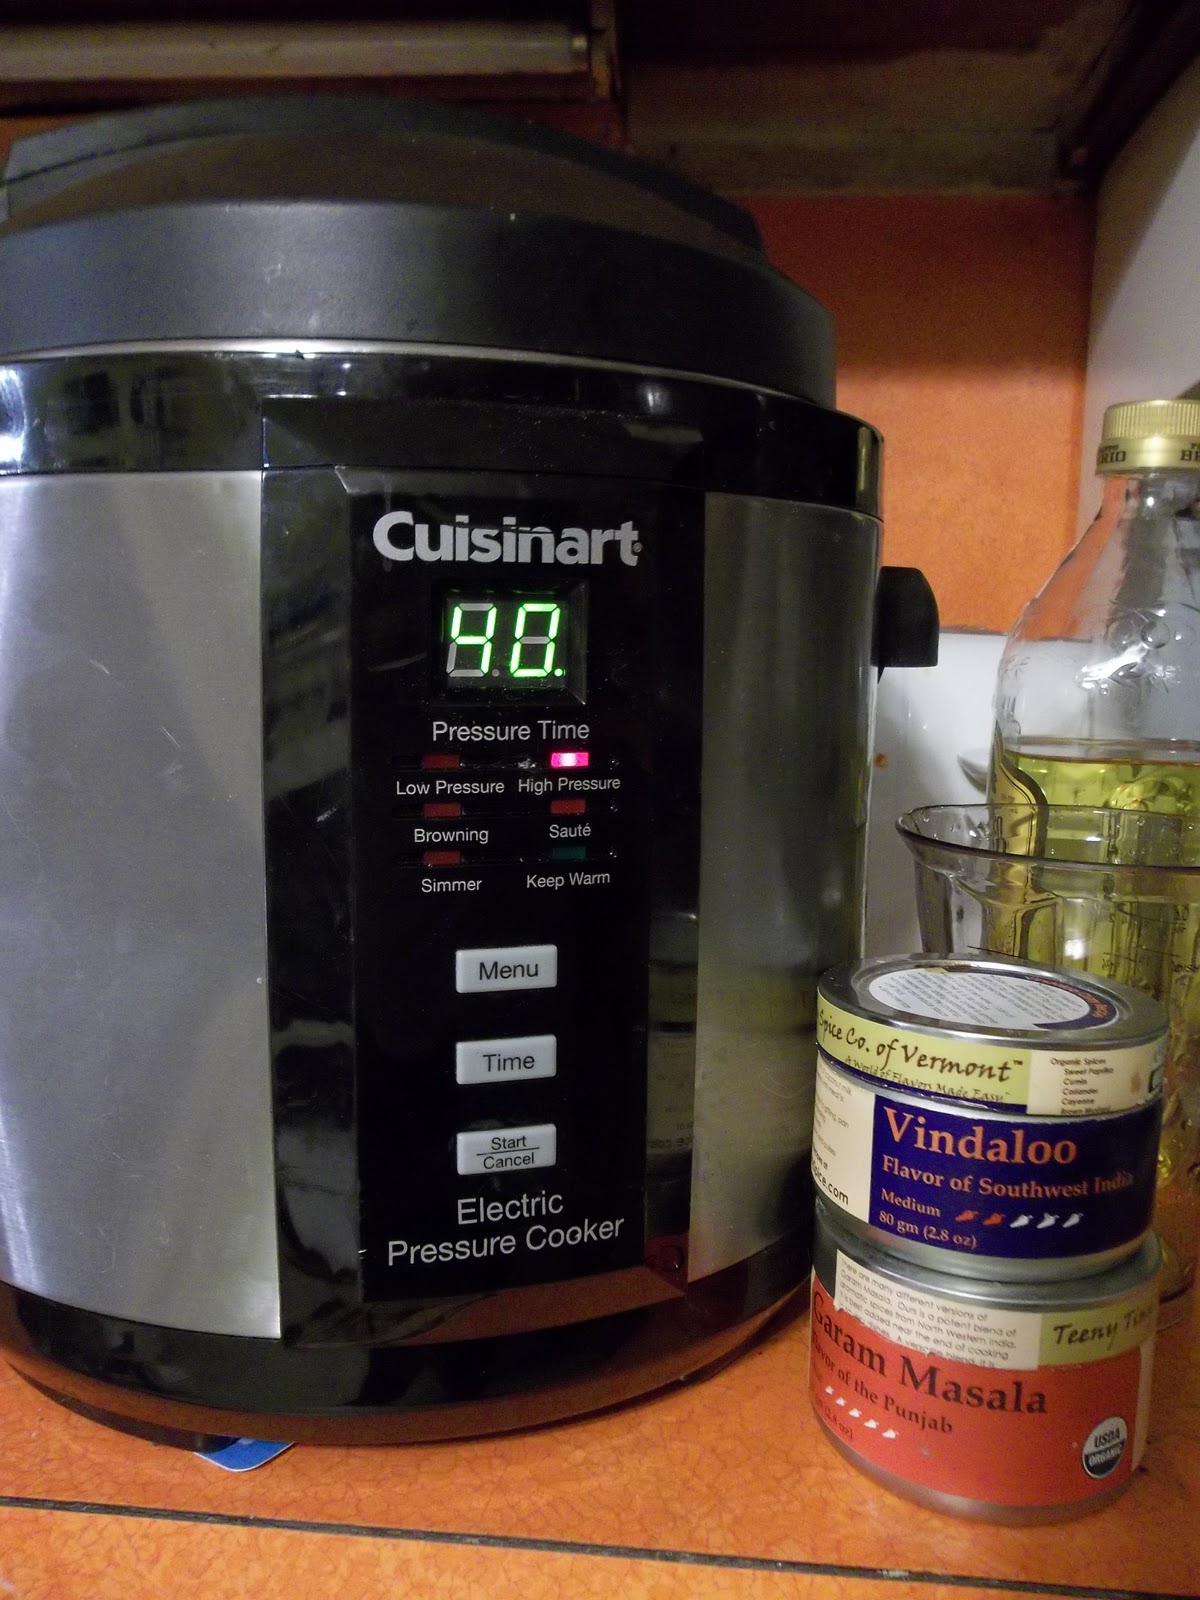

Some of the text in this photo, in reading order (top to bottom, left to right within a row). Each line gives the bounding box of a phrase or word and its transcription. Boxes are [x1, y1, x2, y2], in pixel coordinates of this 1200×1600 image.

[432, 720, 590, 742] Pressure Time
[396, 780, 505, 796] Low Pressure
[518, 777, 621, 796] High Pressure
[414, 828, 489, 845] Browning
[549, 823, 592, 839] Sauté
[421, 879, 482, 893] Simmer
[526, 872, 611, 890] Keep Warm
[479, 961, 540, 981] Menu
[846, 1027, 870, 1052] Co.
[876, 1038, 899, 1071] of
[1050, 1057, 1107, 1067] Organic Spices
[482, 1052, 536, 1073] Time
[853, 1058, 878, 1077] World
[936, 1083, 969, 1099] Made
[491, 1136, 527, 1151] Start
[883, 1105, 1077, 1165] Vindaloo
[483, 1151, 535, 1170] Cancel
[883, 1154, 944, 1188] Flavor
[949, 1175, 974, 1193] of
[978, 1178, 1088, 1198] Southwest
[457, 1190, 564, 1225] Electric
[881, 1188, 940, 1217] Medium
[388, 1217, 625, 1267] Pressure Cooker
[879, 1210, 977, 1249] 80 gm (2.8 oz)
[841, 1269, 862, 1290] Garam
[927, 1313, 935, 1321] a
[936, 1316, 971, 1329] potent
[871, 1279, 894, 1296] many
[895, 1290, 934, 1309] different
[935, 1304, 974, 1320] versions
[976, 1313, 988, 1321] of
[895, 1312, 915, 1325] from
[917, 1320, 944, 1335] North
[1053, 1321, 1119, 1351] Teeny
[813, 1291, 1047, 1414] Garam Masala
[915, 1331, 931, 1343] the
[933, 1338, 953, 1350] end
[967, 1346, 1009, 1361] cooking
[837, 1368, 852, 1385] of
[854, 1379, 878, 1404] the
[884, 1394, 953, 1433] Punjab
[1094, 1427, 1121, 1448] USDA
